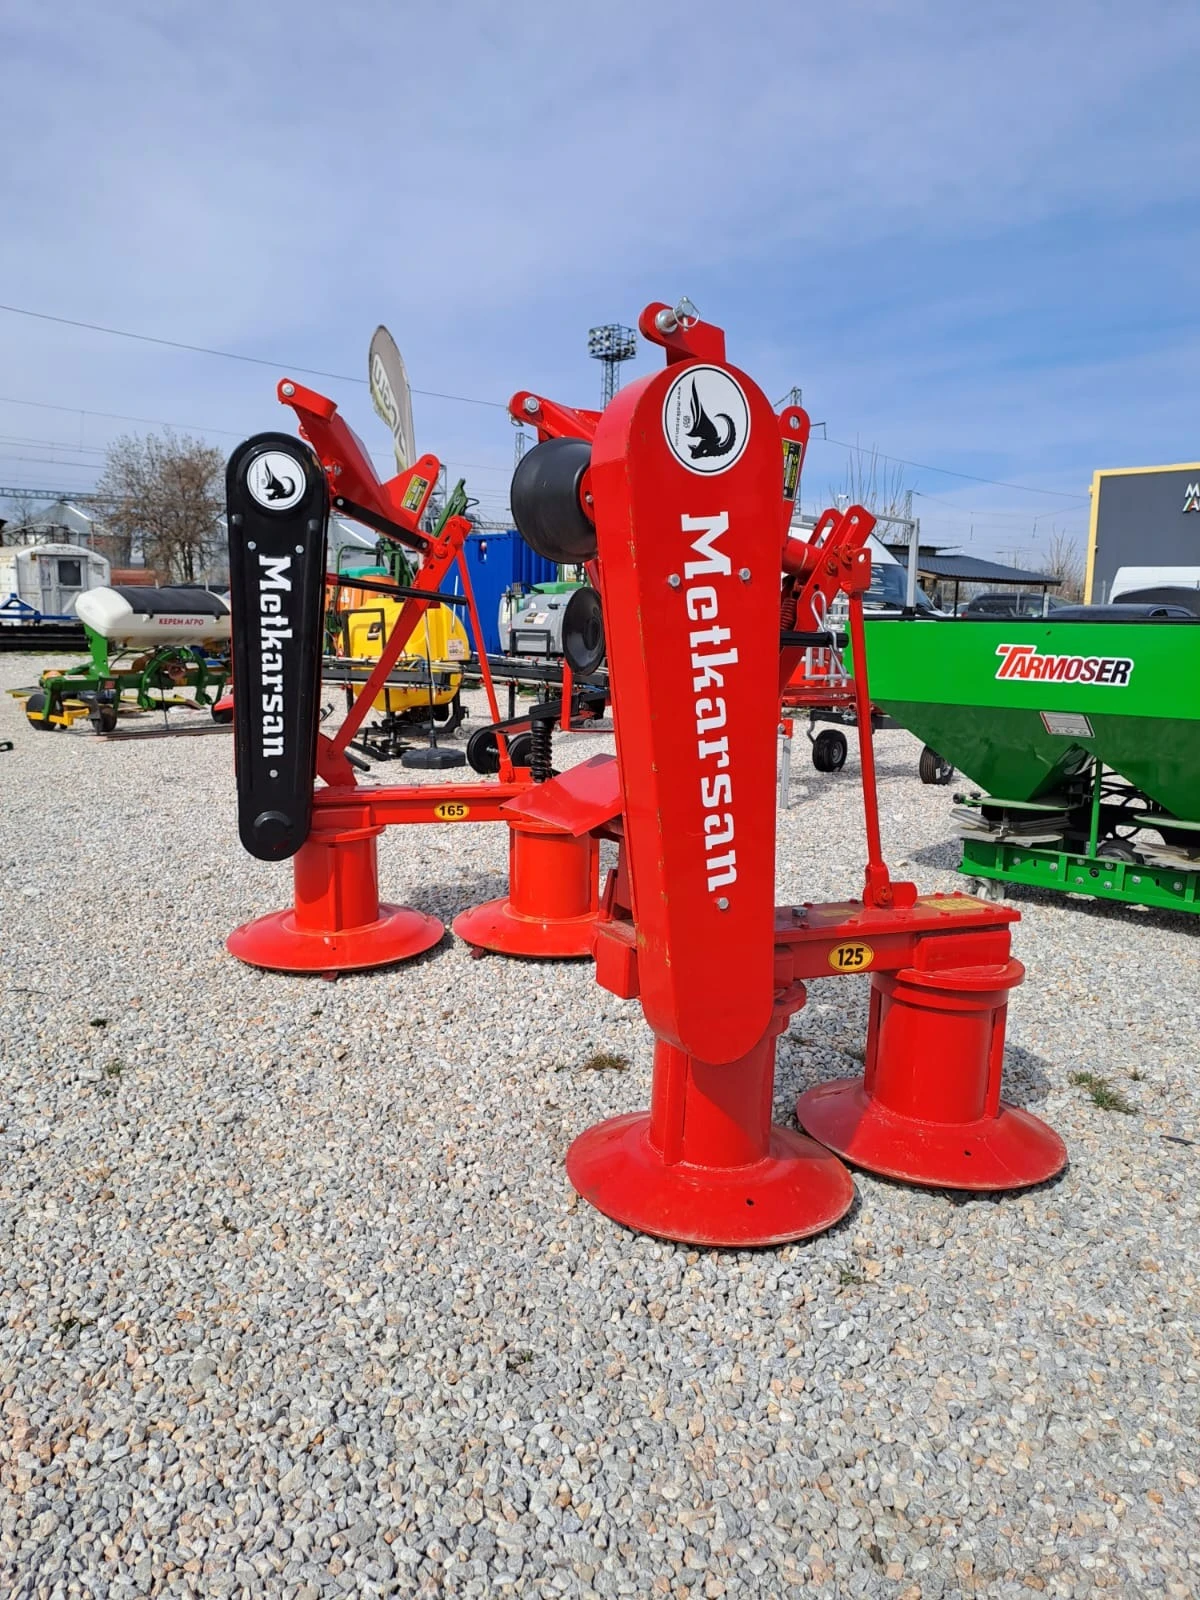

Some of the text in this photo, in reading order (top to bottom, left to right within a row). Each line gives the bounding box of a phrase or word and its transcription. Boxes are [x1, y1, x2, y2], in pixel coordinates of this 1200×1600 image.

[258, 555, 294, 757] Metkarsan
[997, 645, 1133, 685] TARMOSER
[680, 511, 738, 893] Metkarsan
[439, 805, 464, 816] 165
[837, 947, 864, 966] 125
